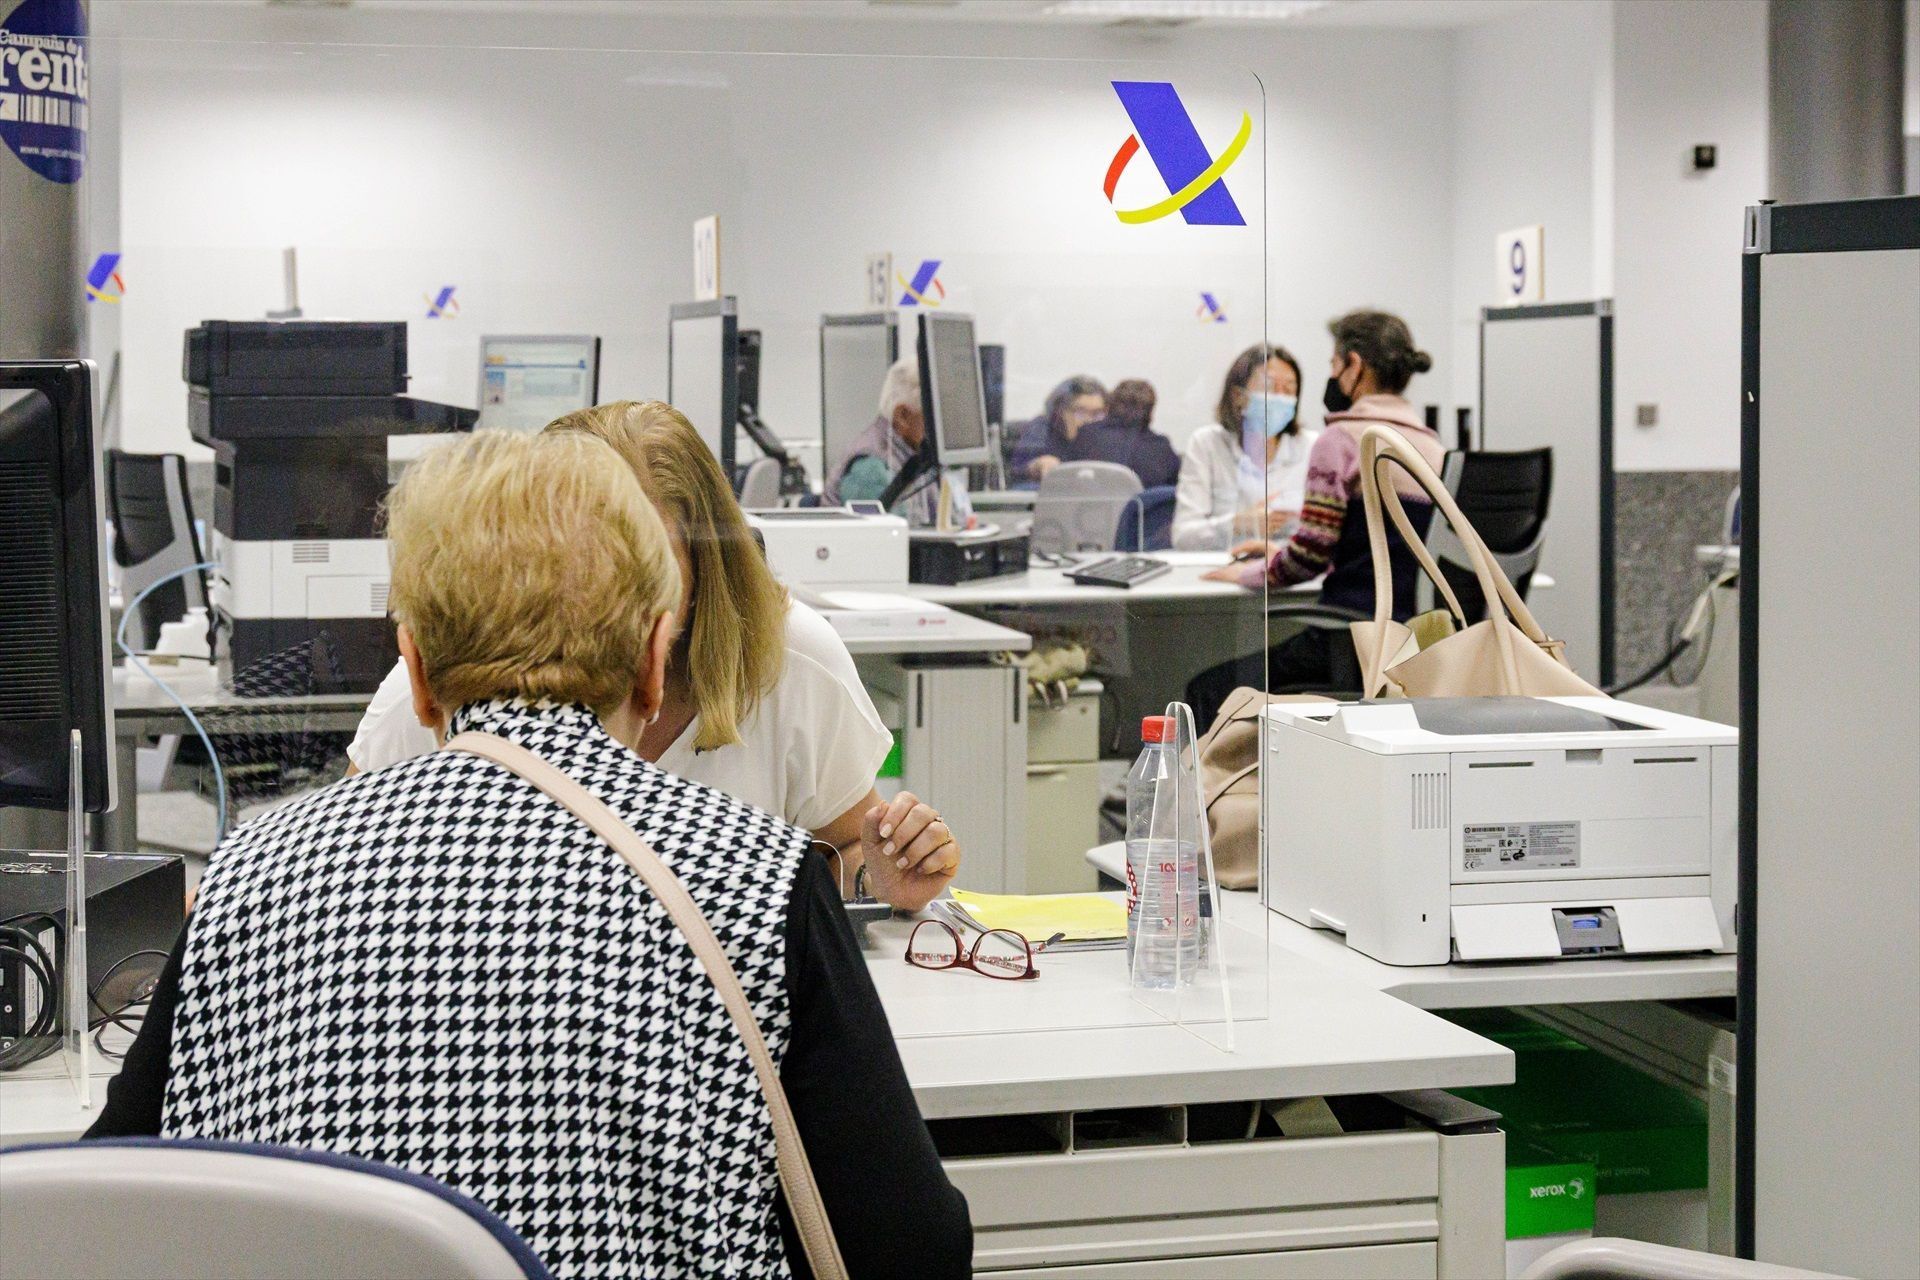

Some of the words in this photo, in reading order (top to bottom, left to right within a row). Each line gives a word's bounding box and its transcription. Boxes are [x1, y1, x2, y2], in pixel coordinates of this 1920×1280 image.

[0, 45, 88, 98] rent
[1510, 240, 1526, 295] 9
[1530, 1183, 1566, 1198] xerox
